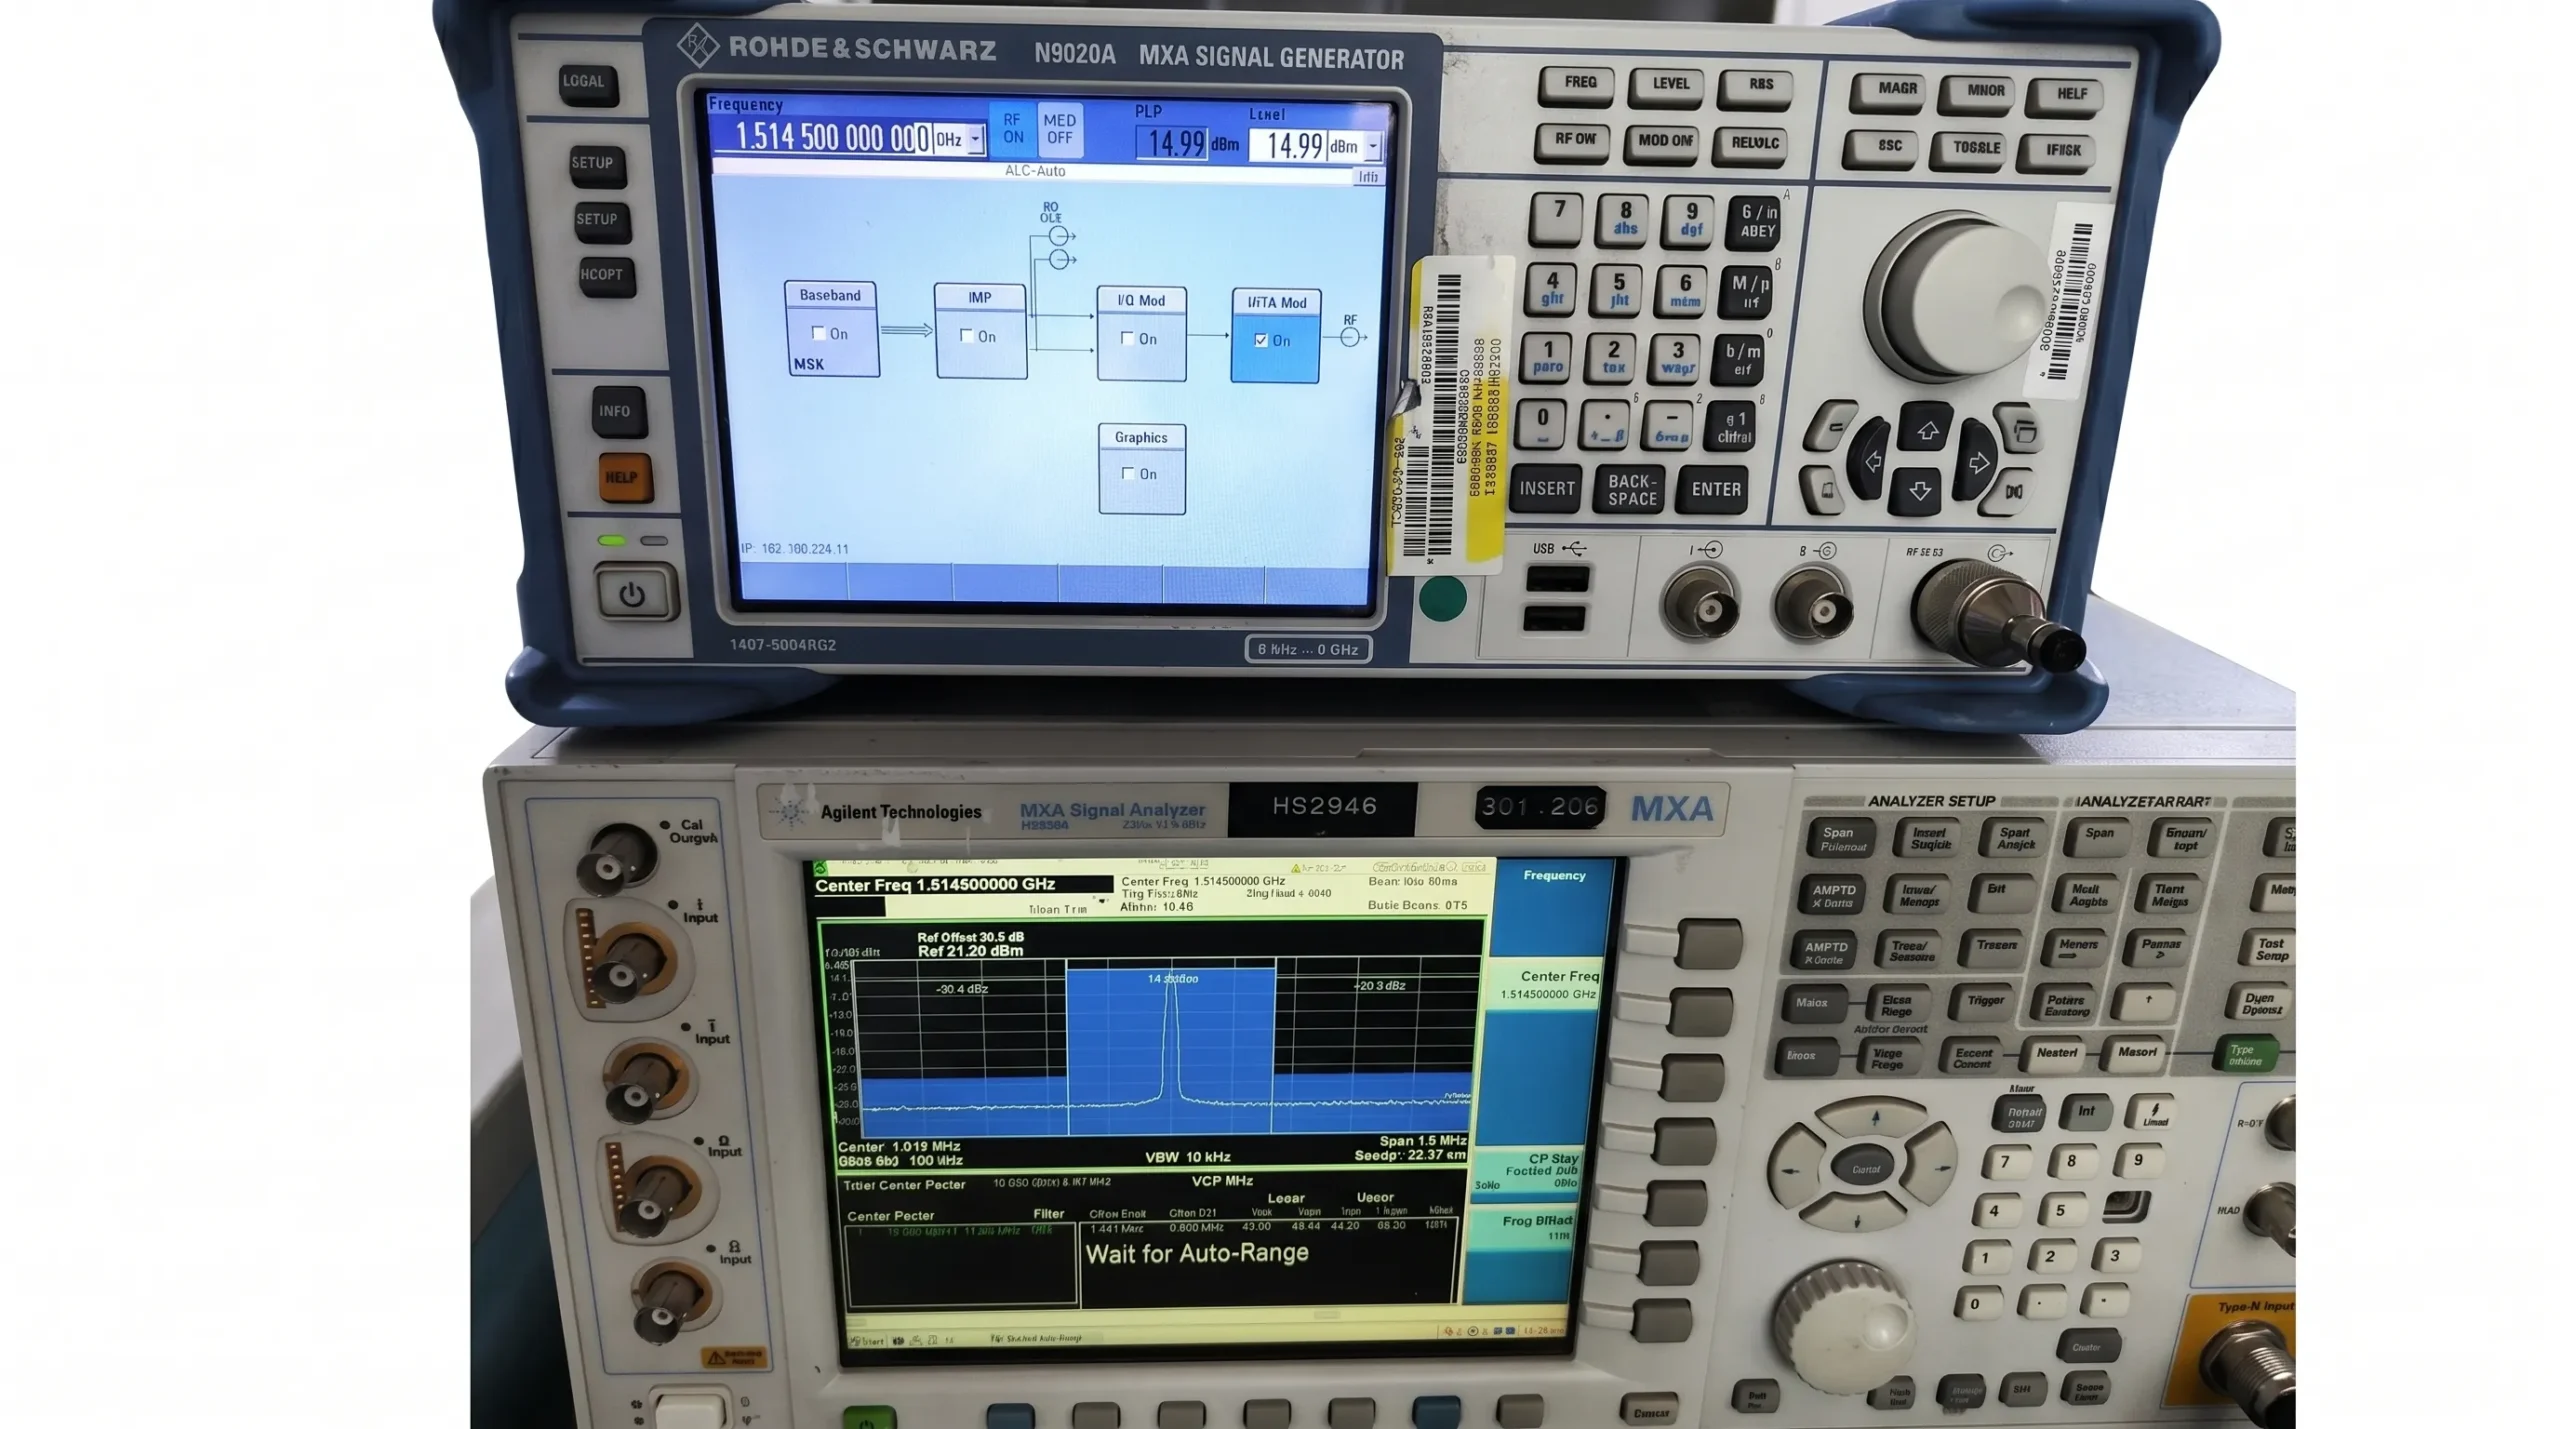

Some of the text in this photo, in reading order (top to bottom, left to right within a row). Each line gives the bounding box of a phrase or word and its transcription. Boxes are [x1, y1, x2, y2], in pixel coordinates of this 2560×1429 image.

[1035, 42, 1404, 70] N9020A MXA SIGNAL GENERATOR
[1654, 78, 1690, 89] LEVEL
[1968, 84, 2005, 96] MNOR
[2058, 88, 2088, 99] HELF
[709, 97, 783, 114] Frequency
[1136, 105, 1162, 118] PLP
[1004, 113, 1020, 125] RF
[1044, 114, 1076, 127] MED
[737, 122, 794, 150] 1.514
[803, 123, 838, 151] 500
[846, 124, 883, 151] 000
[891, 124, 929, 152] 000
[1004, 130, 1024, 143] ON
[1048, 131, 1073, 144] OFF
[1556, 134, 1572, 144] RF
[1639, 135, 1668, 146] MOD
[1150, 130, 1239, 157] 14.99 dBm
[1268, 132, 1358, 159] 14.99 dBm
[572, 157, 613, 169] SETUP
[1005, 165, 1066, 177] ALC-Auto
[1555, 200, 1566, 217] 7
[1621, 202, 1632, 218] 8
[1687, 203, 1698, 219] 9
[577, 214, 617, 225] SETUP
[1742, 226, 1776, 237] ABEY
[581, 269, 623, 280] HCOPT
[1547, 273, 1559, 288] 4
[1614, 274, 1625, 289] 5
[1680, 275, 1691, 291] 6
[800, 289, 861, 302] Baseband
[969, 292, 992, 303] IMP
[1140, 295, 1165, 307] Mod
[1281, 297, 1307, 309] Mod
[1344, 314, 1357, 325] RF
[830, 328, 848, 340] On
[978, 331, 996, 343] On
[1139, 333, 1157, 345] On
[1273, 335, 1290, 347] On
[1544, 342, 1552, 357] 1
[1609, 342, 1620, 357] 2
[1673, 342, 1684, 357] 3
[794, 359, 824, 370] MSK
[600, 406, 630, 416] INFO
[1538, 409, 1548, 424] 0
[1114, 431, 1169, 446] Graphics
[606, 472, 637, 483] HELP
[1140, 468, 1157, 480] On
[1609, 475, 1657, 487] BACK-
[1520, 482, 1575, 494] INSERT
[1692, 483, 1741, 496] ENTER
[1609, 493, 1657, 505] SPACE
[1533, 543, 1554, 555] USB
[1906, 548, 1918, 557] RF
[730, 639, 836, 651] 1407-5004RG2
[1330, 644, 1358, 656] GHz
[1274, 797, 1377, 815] HS2946
[1869, 796, 1996, 806] ANALYZER SETUP
[821, 804, 982, 821] Agilent Technologies
[1020, 803, 1206, 820] MXA Signal Analyzer
[1631, 796, 1714, 821] MXA
[682, 820, 702, 830] Cal
[1824, 828, 1853, 838] Span
[2086, 828, 2114, 839] Span
[1122, 876, 1285, 888] Center Freq 1.514500000 GHz
[1524, 870, 1586, 883] Frequency
[816, 878, 1056, 894] Center Freq 1.514500000 GHz
[1813, 886, 1856, 895] AMPTD
[1164, 902, 1193, 911] 10.46
[684, 913, 718, 925] Input
[918, 932, 938, 942] Ref
[980, 932, 1004, 942] 30.5
[1008, 932, 1024, 942] dB
[918, 945, 1023, 957] Ref 21.20 dBm
[1806, 943, 1848, 951] AMPTD
[1522, 971, 1599, 984] Center Freq
[1502, 990, 1596, 999] 1.514500000 GHz
[696, 1034, 730, 1046] Input
[2079, 1106, 2095, 1117] Int
[839, 1142, 884, 1152] Center
[933, 1141, 960, 1151] MHz
[1380, 1136, 1467, 1148] Span 1.5 MHz
[709, 1148, 742, 1159] Input
[1146, 1151, 1231, 1163] VBW 10 kHz
[1408, 1150, 1443, 1160] 22.37
[1530, 1154, 1579, 1165] CP Stay
[910, 1156, 933, 1165] 100
[2001, 1156, 2010, 1168] 7
[2067, 1155, 2076, 1167] 8
[2134, 1154, 2143, 1166] 9
[879, 1180, 966, 1190] Center Pecter
[1193, 1175, 1253, 1187] VCP MHz
[848, 1211, 935, 1221] Center Pecter
[1034, 1209, 1064, 1219] Filter
[1990, 1205, 1999, 1217] 4
[2056, 1205, 2065, 1216] 5
[1503, 1217, 1532, 1227] Frog
[720, 1255, 751, 1265] Input
[1086, 1243, 1309, 1266] Wait for Auto-Range
[1982, 1253, 1988, 1264] 1
[2045, 1251, 2055, 1262] 2
[2111, 1250, 2120, 1262] 3
[1971, 1299, 1979, 1309] 0
[2219, 1302, 2295, 1312] Type-N Input
